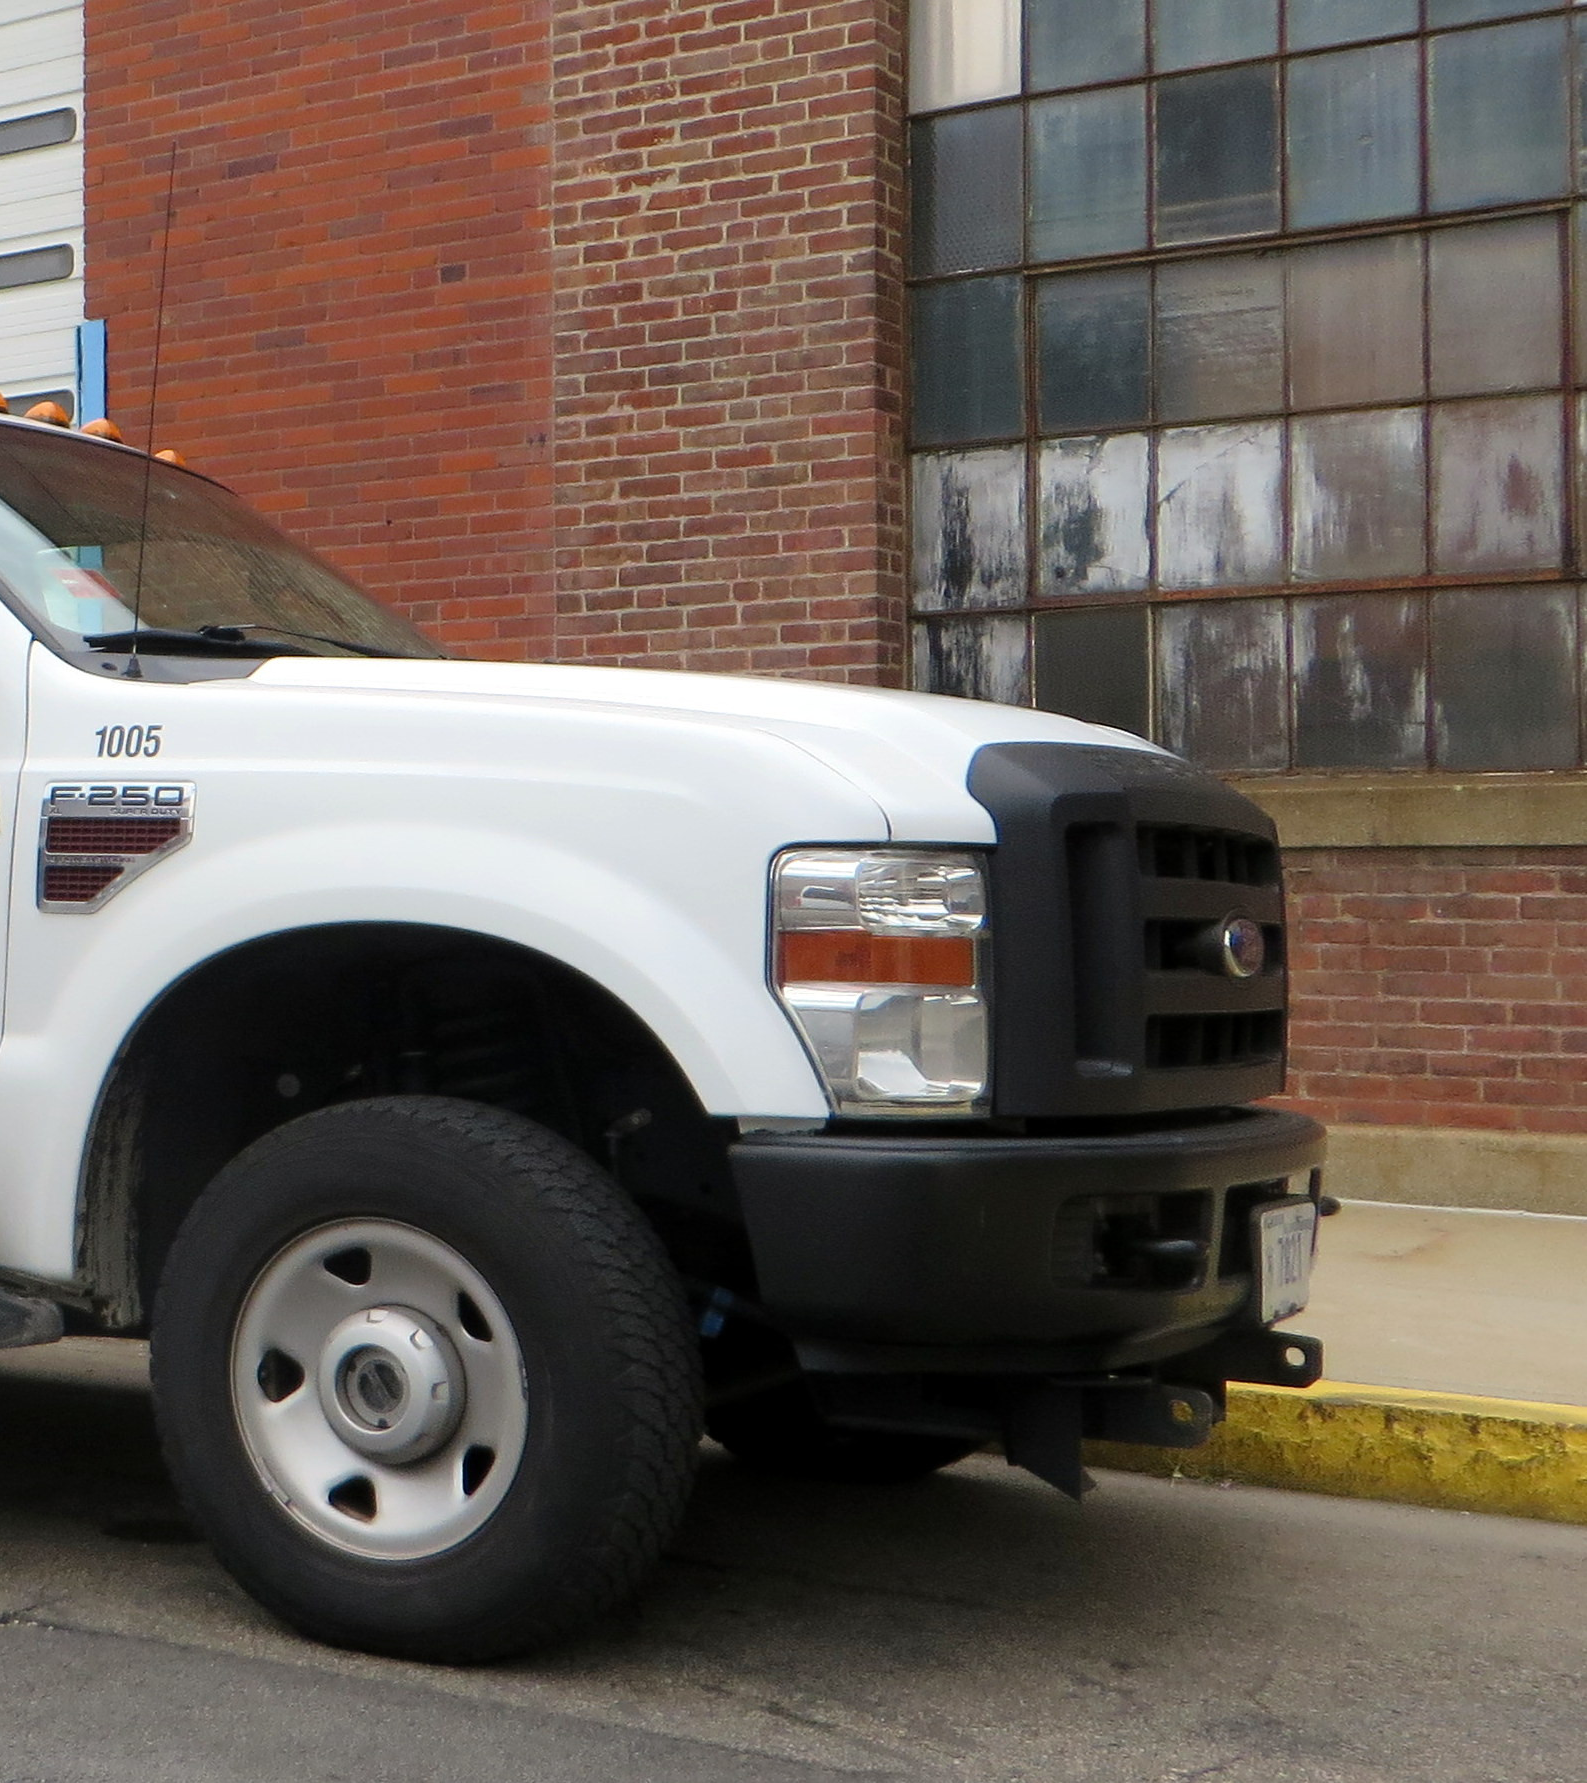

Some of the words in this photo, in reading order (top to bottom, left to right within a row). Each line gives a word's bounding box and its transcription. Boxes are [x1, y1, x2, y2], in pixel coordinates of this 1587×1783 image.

[95, 724, 163, 758] 1005
[50, 786, 184, 807] F-250
[150, 807, 182, 816] DUTY
